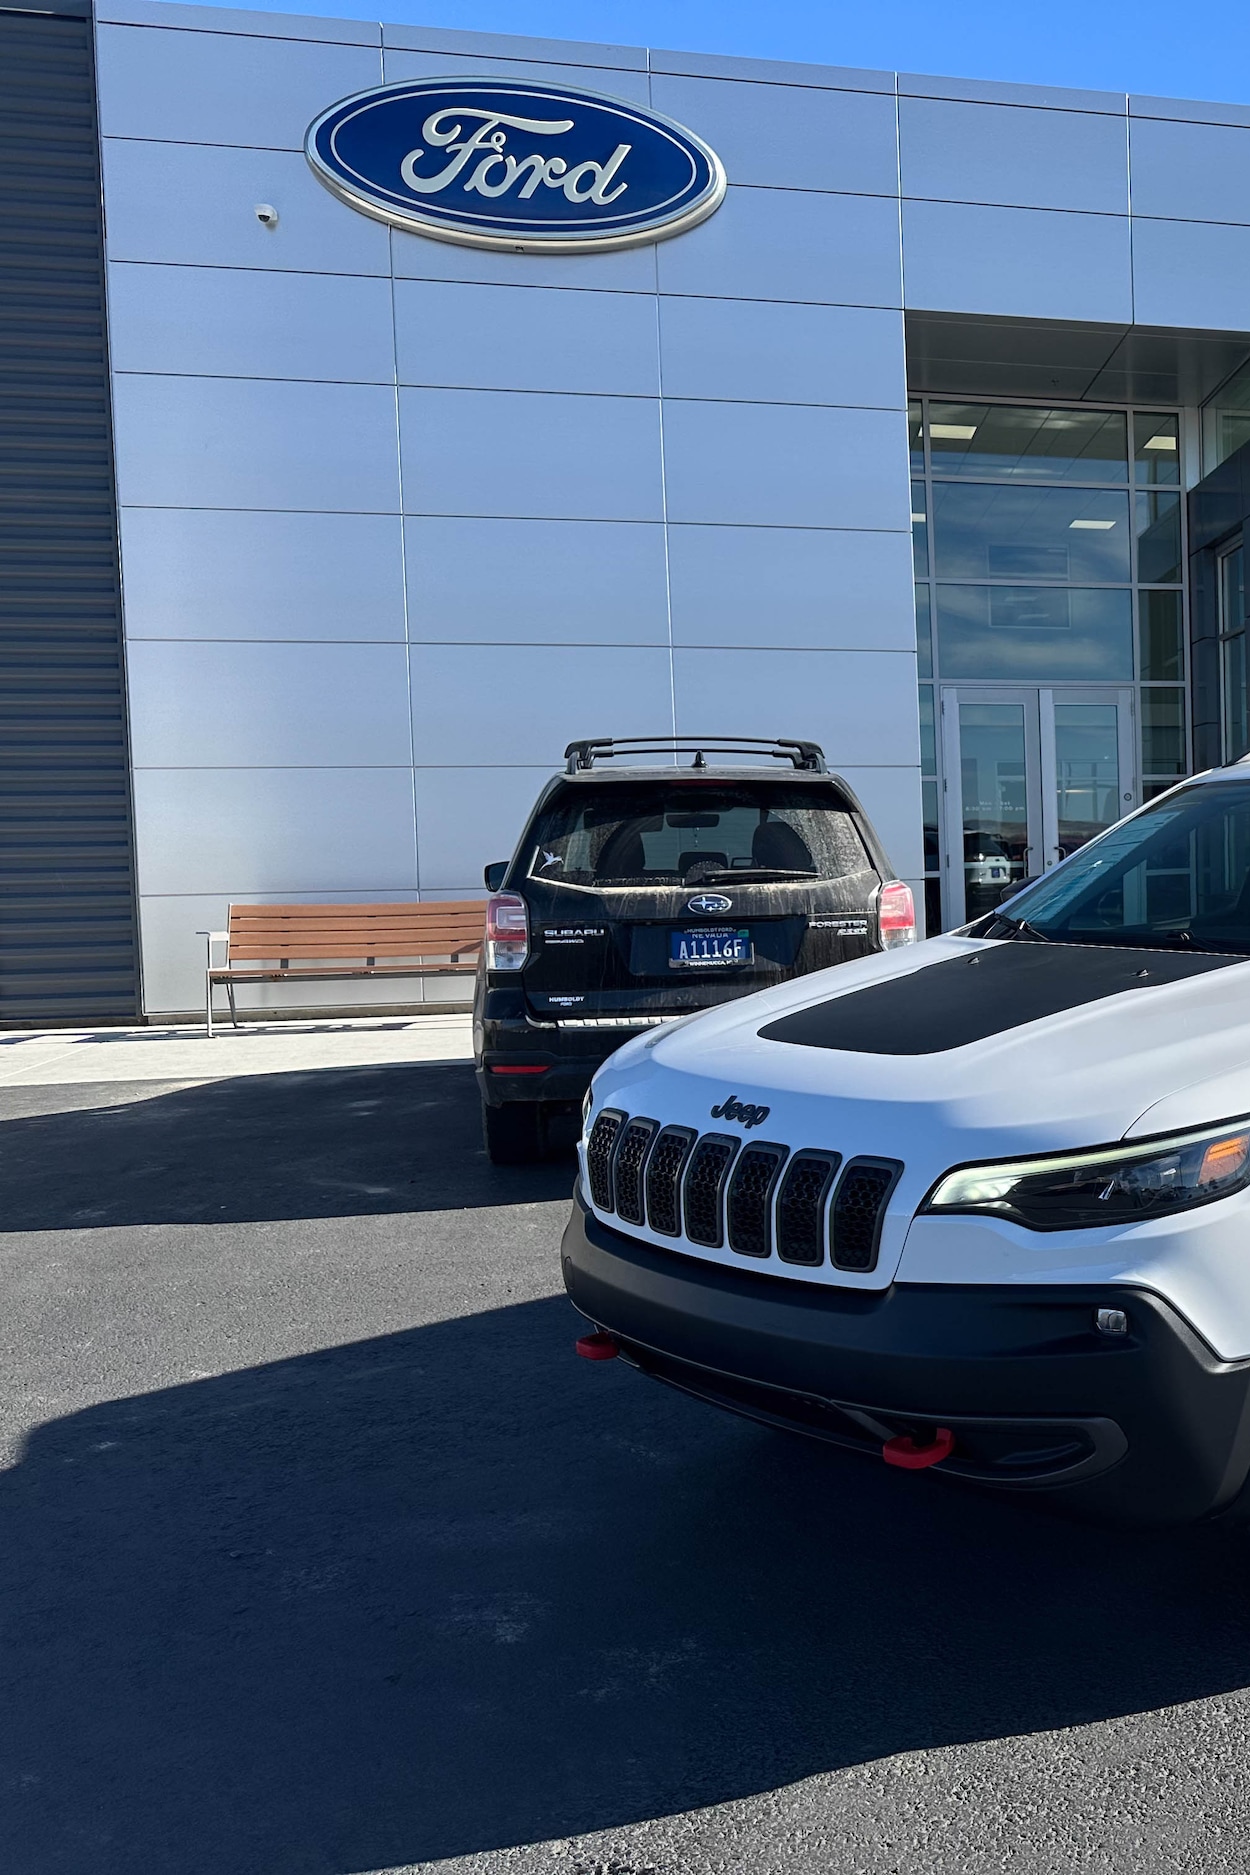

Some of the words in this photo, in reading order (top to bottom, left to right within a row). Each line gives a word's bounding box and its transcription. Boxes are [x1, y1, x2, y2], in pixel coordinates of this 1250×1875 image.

[401, 107, 632, 206] Ford
[544, 929, 605, 937] SUBARU
[808, 920, 868, 928] FORESTER
[680, 939, 742, 959] A1116F
[711, 1095, 770, 1129] Jeep
